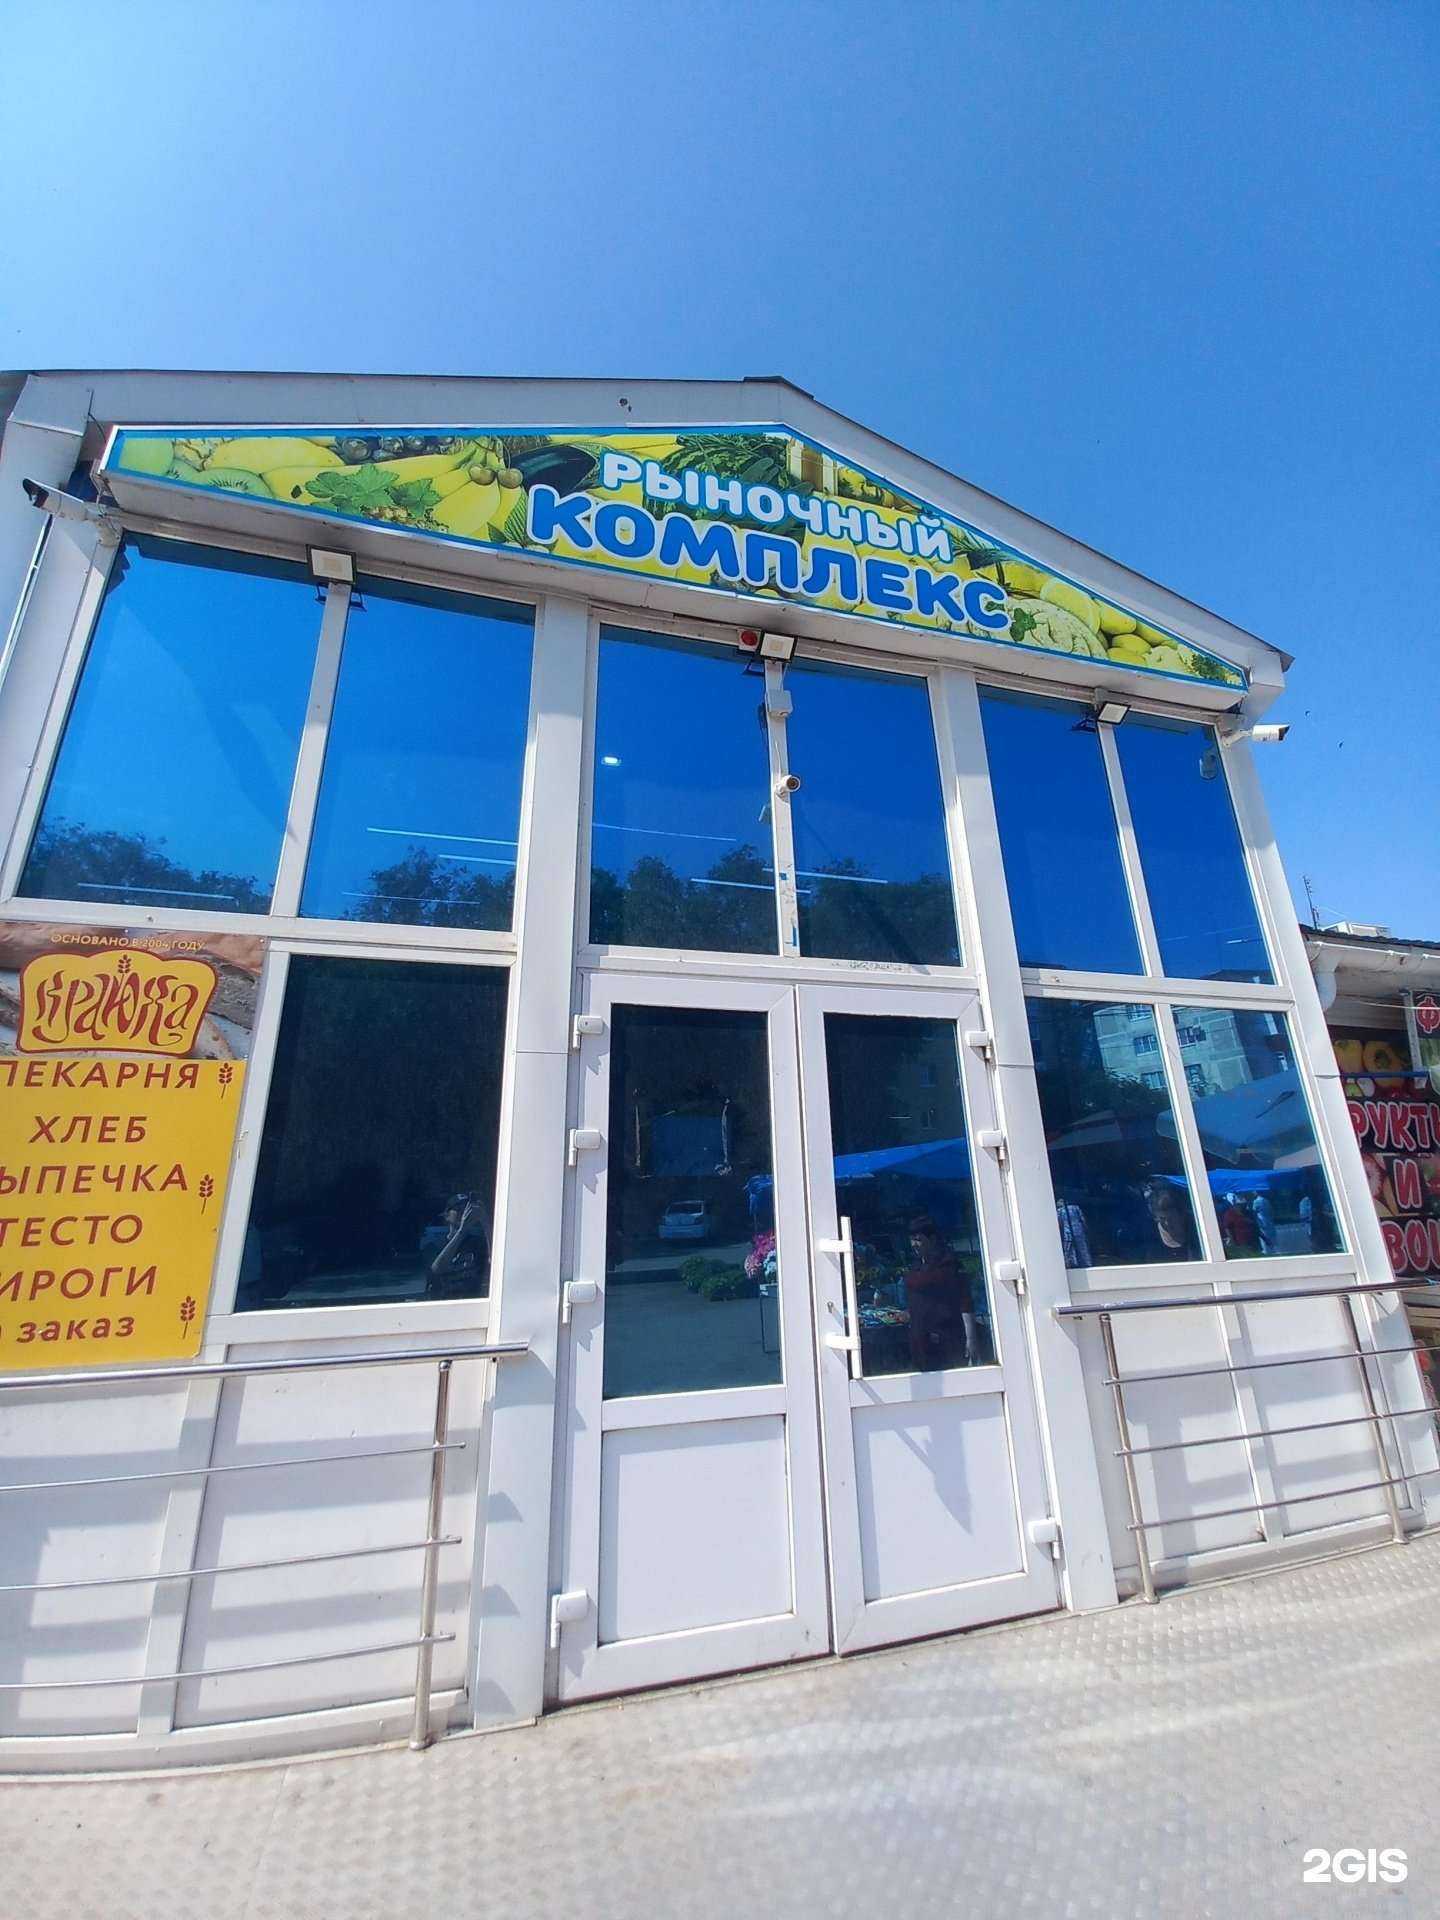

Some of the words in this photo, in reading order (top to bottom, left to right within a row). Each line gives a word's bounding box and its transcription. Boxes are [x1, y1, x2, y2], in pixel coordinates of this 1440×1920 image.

[602, 452, 953, 563] РЫНОЧНЫЙ
[526, 484, 1011, 630] КОМПЛЕКС
[50, 933, 129, 948] ОСНОВАНО
[28, 1115, 147, 1144] ХЛЕБ
[1393, 1158, 1422, 1209] И
[0, 1214, 143, 1248] ТЕСТО
[0, 1265, 158, 1302] ИРОГИ
[16, 1316, 135, 1344] заказ
